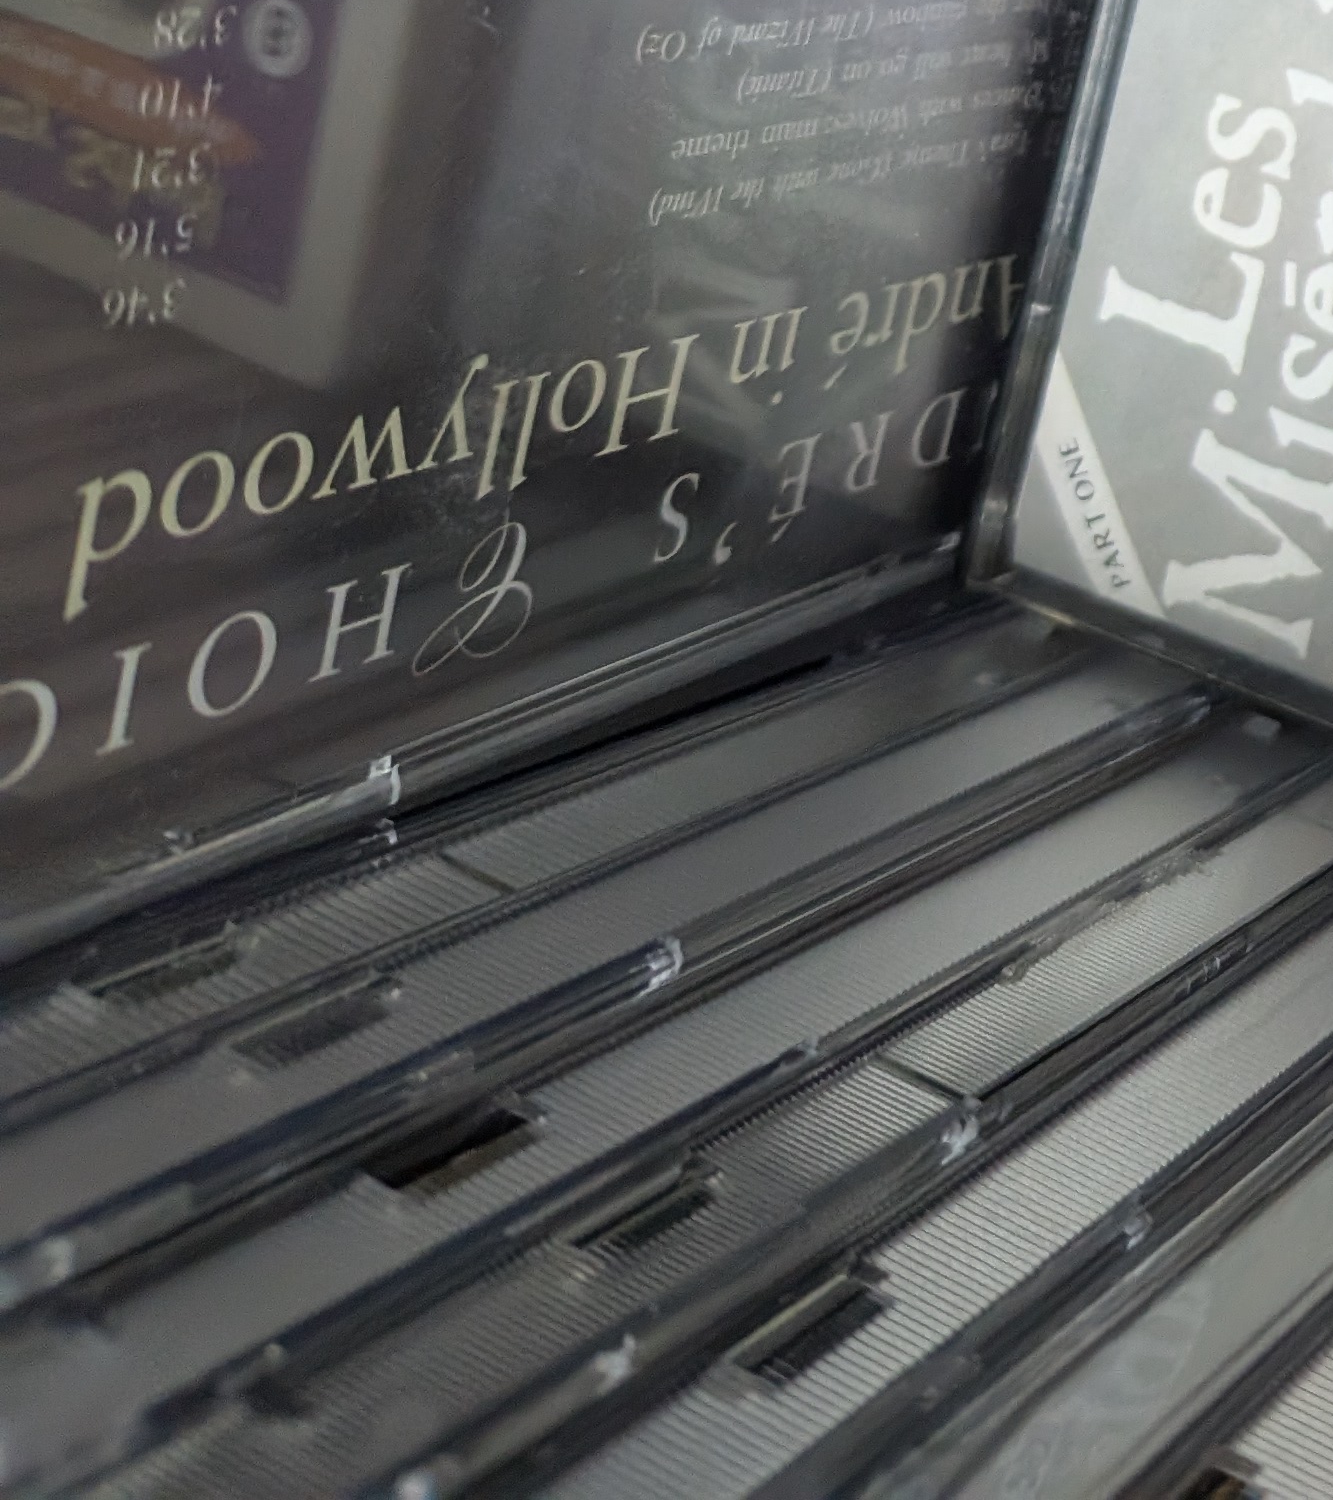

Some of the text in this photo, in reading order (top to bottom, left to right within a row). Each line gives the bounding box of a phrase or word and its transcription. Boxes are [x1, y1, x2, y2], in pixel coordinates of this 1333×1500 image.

[633, 20, 688, 65] Oz)
[692, 13, 724, 57] of
[728, 15, 816, 55] Wizard
[136, 71, 222, 122] 4'10
[130, 127, 751, 195] theme 3'21
[113, 209, 198, 263] 5'16
[1101, 90, 1298, 372] Les
[101, 274, 187, 329] 3'46
[63, 254, 1024, 622] André in Hollywood
[1058, 438, 1131, 592] PART ONE
